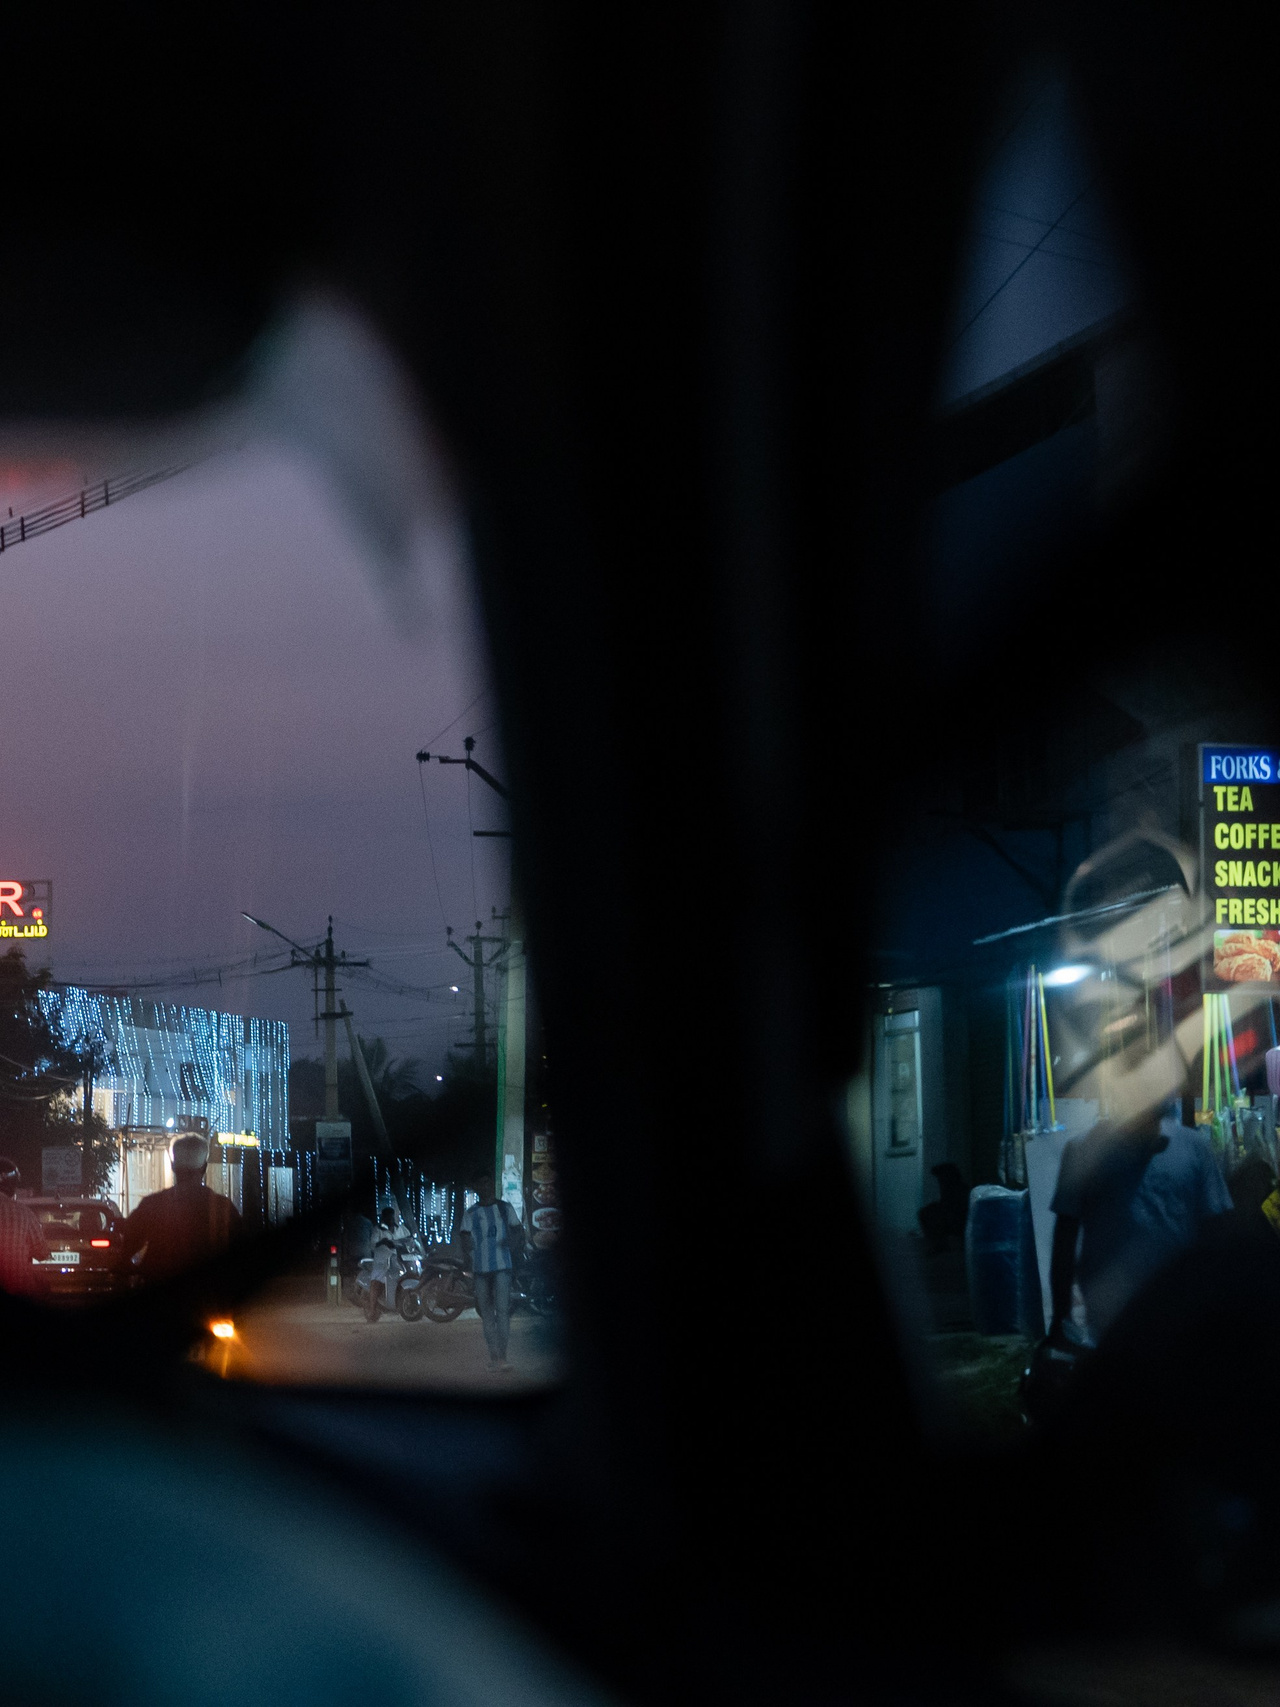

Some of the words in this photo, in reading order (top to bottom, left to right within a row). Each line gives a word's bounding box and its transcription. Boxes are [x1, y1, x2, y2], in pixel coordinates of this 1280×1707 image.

[1210, 755, 1271, 780] FORKS
[1213, 785, 1254, 812] TEA
[1215, 897, 1280, 925] FRESH
